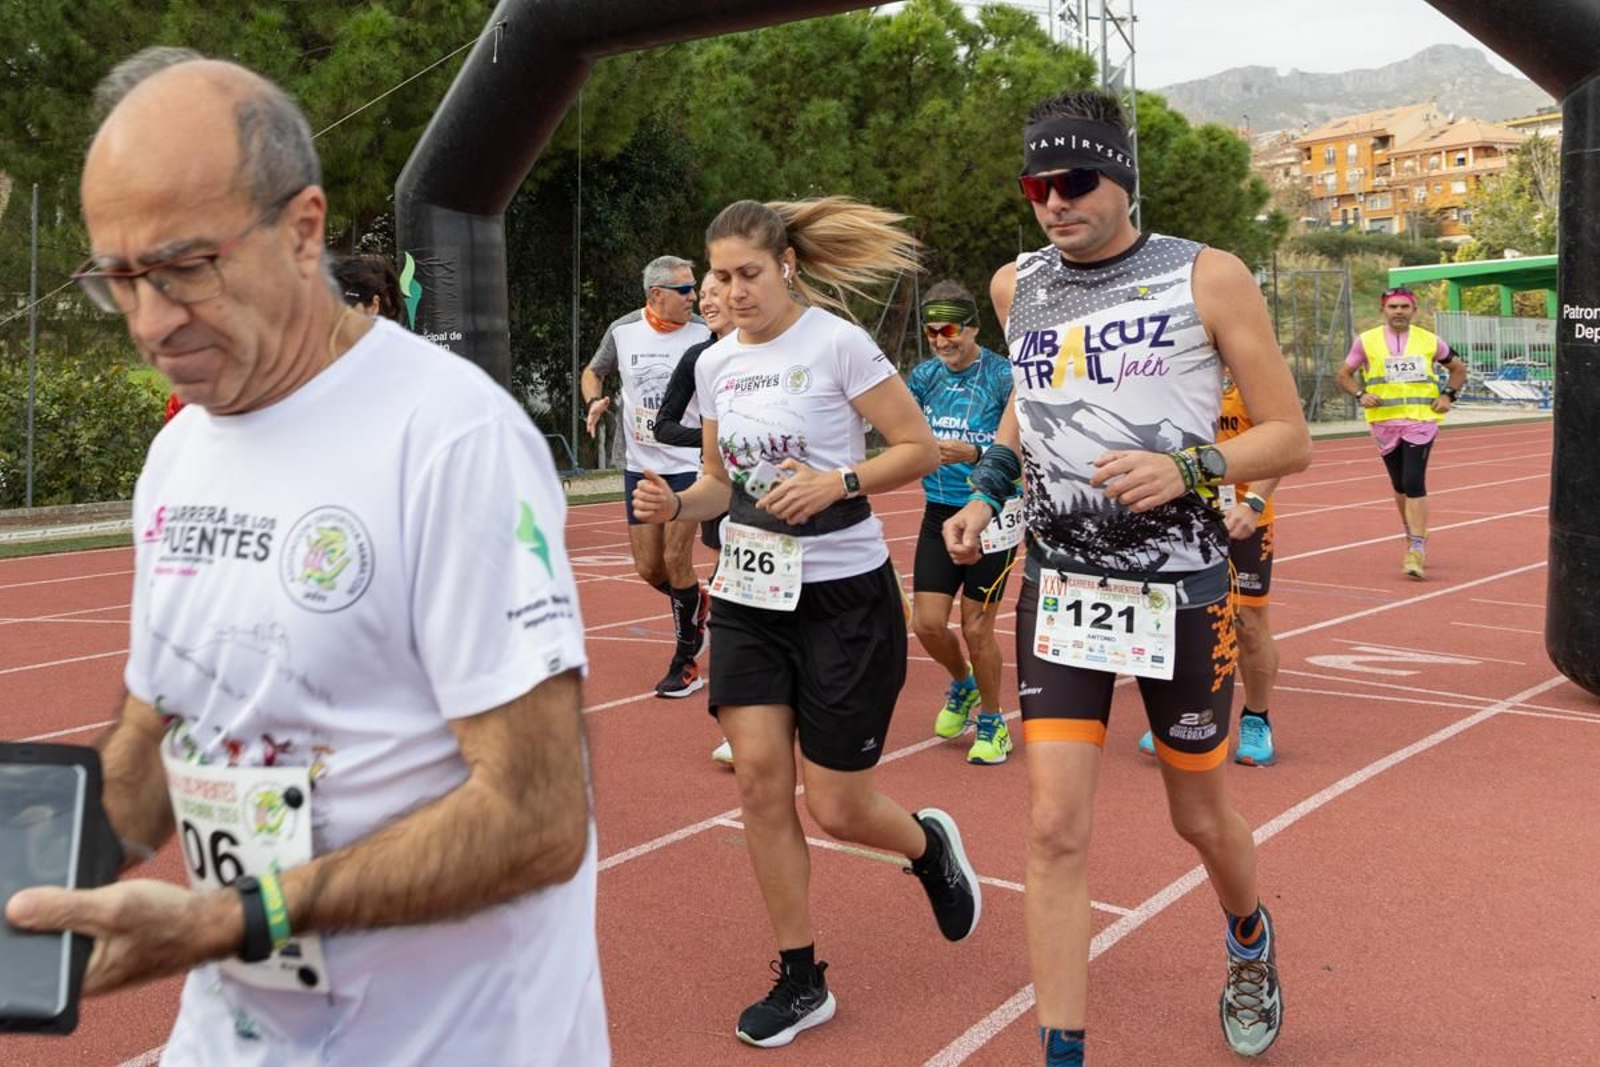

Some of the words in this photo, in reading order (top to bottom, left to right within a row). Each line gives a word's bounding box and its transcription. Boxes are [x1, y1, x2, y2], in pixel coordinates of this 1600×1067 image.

[449, 331, 461, 341] de
[1113, 352, 1171, 392] Jaén
[1393, 362, 1416, 372] 123
[734, 379, 780, 392] PUENTES
[932, 415, 970, 430] MEDIA
[732, 546, 775, 575] 126
[1065, 599, 1135, 634] 121
